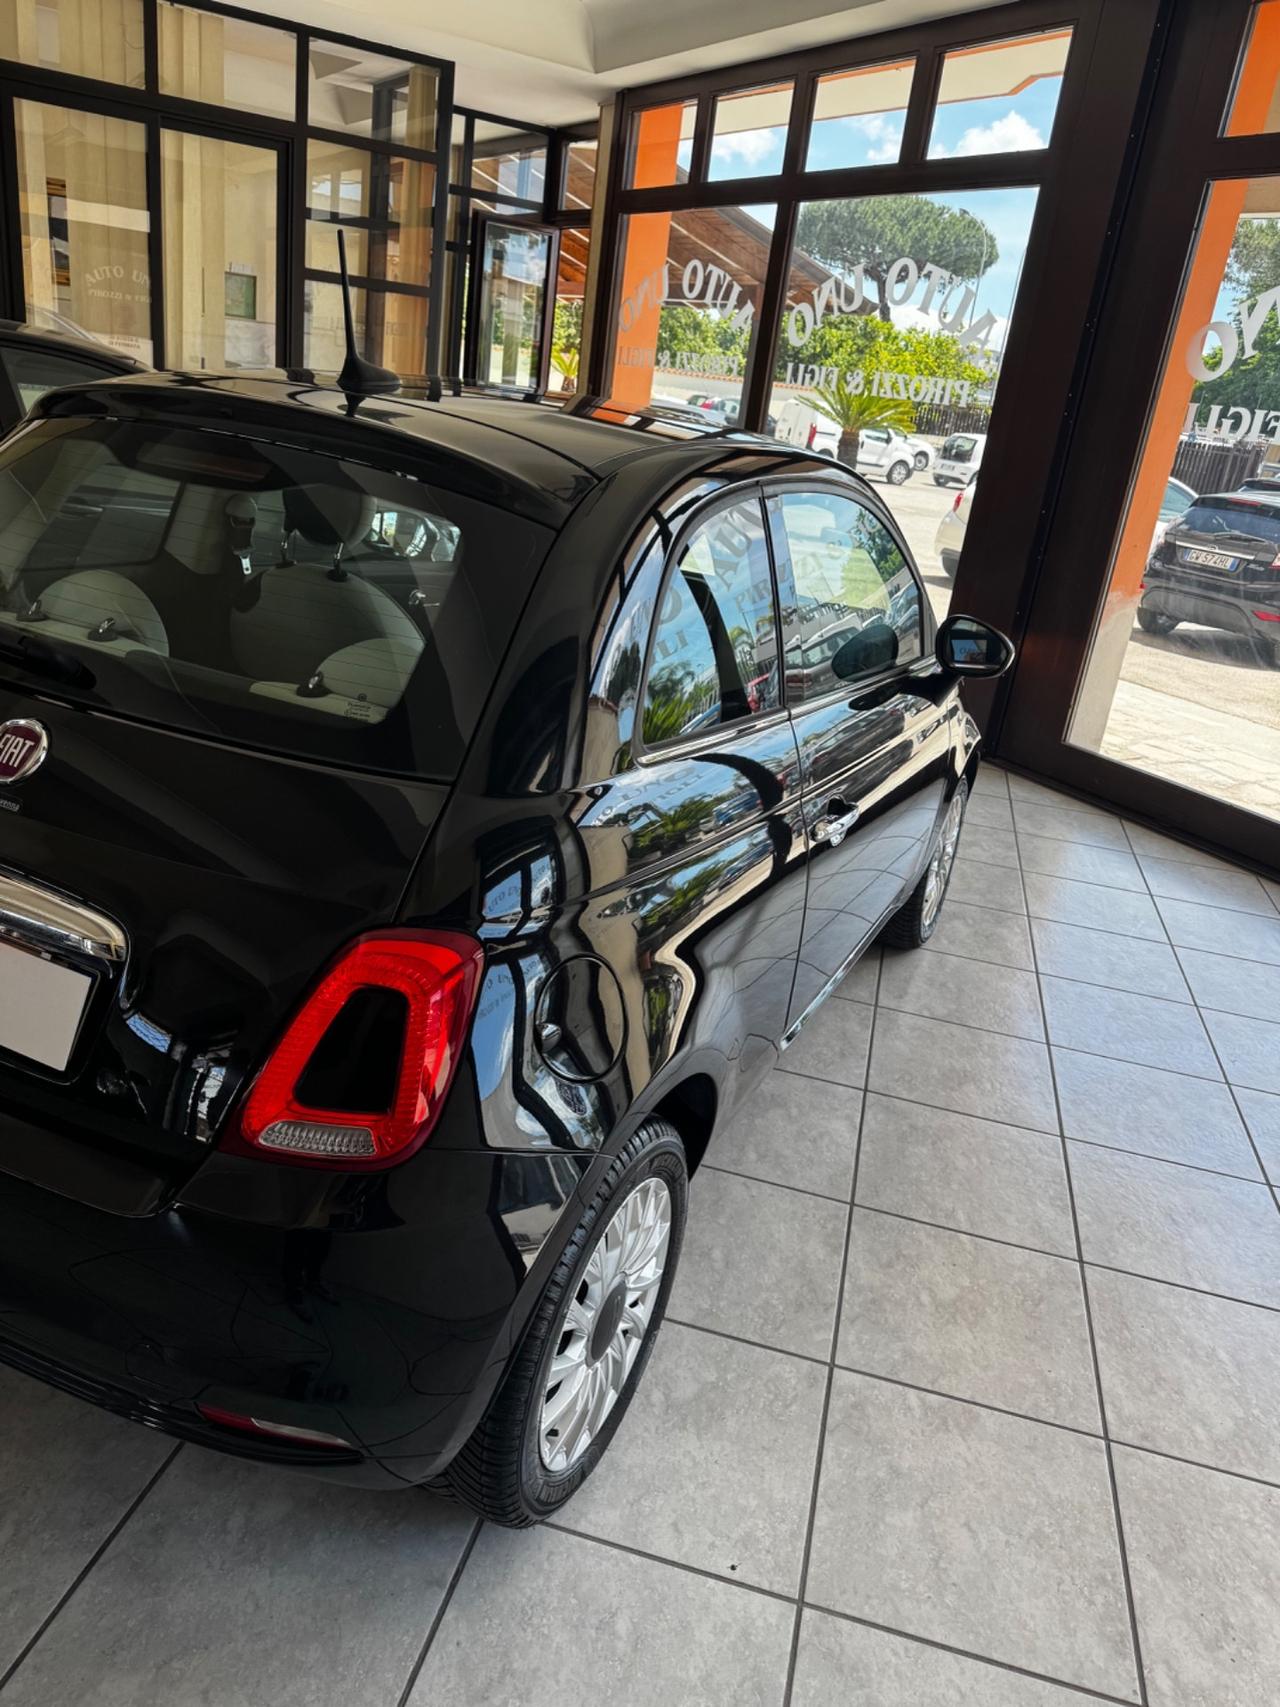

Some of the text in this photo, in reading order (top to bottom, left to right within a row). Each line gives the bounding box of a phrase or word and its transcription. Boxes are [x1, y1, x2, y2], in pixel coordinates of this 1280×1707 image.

[85, 265, 151, 290] AUTO UN
[0, 734, 35, 768] FIAT
